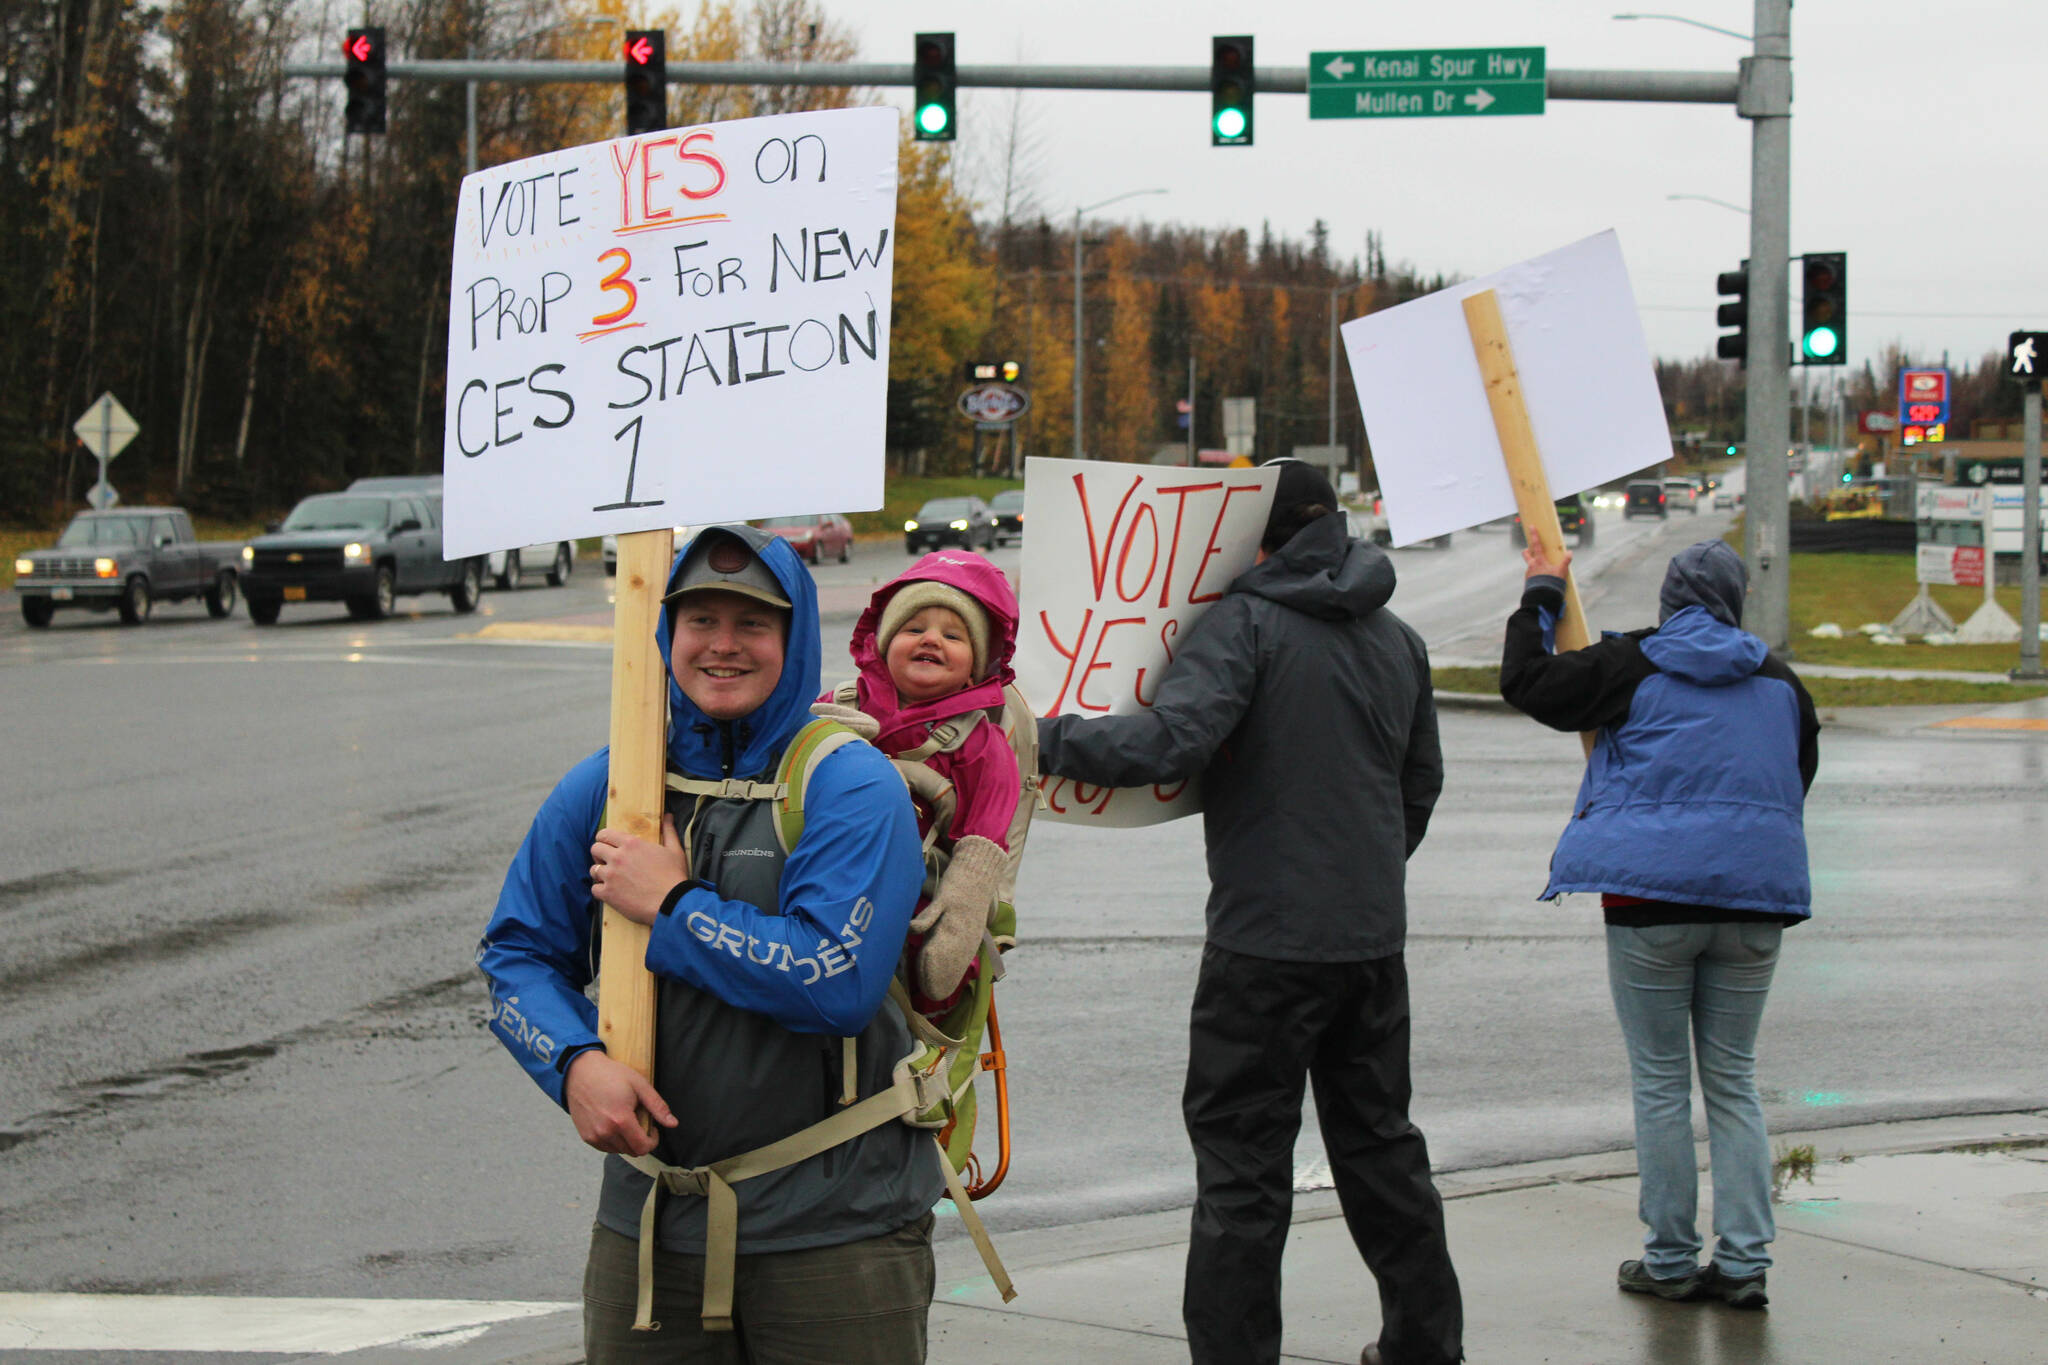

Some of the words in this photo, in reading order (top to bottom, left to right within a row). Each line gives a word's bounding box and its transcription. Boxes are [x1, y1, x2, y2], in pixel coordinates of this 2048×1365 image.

[1356, 90, 1423, 113] Mullen
[1433, 90, 1455, 111] Dr
[1364, 56, 1419, 78] Kenai
[1430, 55, 1477, 81] Spur
[1488, 54, 1531, 80] Hwy
[479, 167, 581, 248] VOTE
[610, 129, 729, 227] YES
[769, 227, 888, 293] NEW
[457, 363, 575, 458] CES
[608, 309, 877, 410] STATION
[593, 415, 665, 512] 1
[1072, 472, 1262, 609] VOTE
